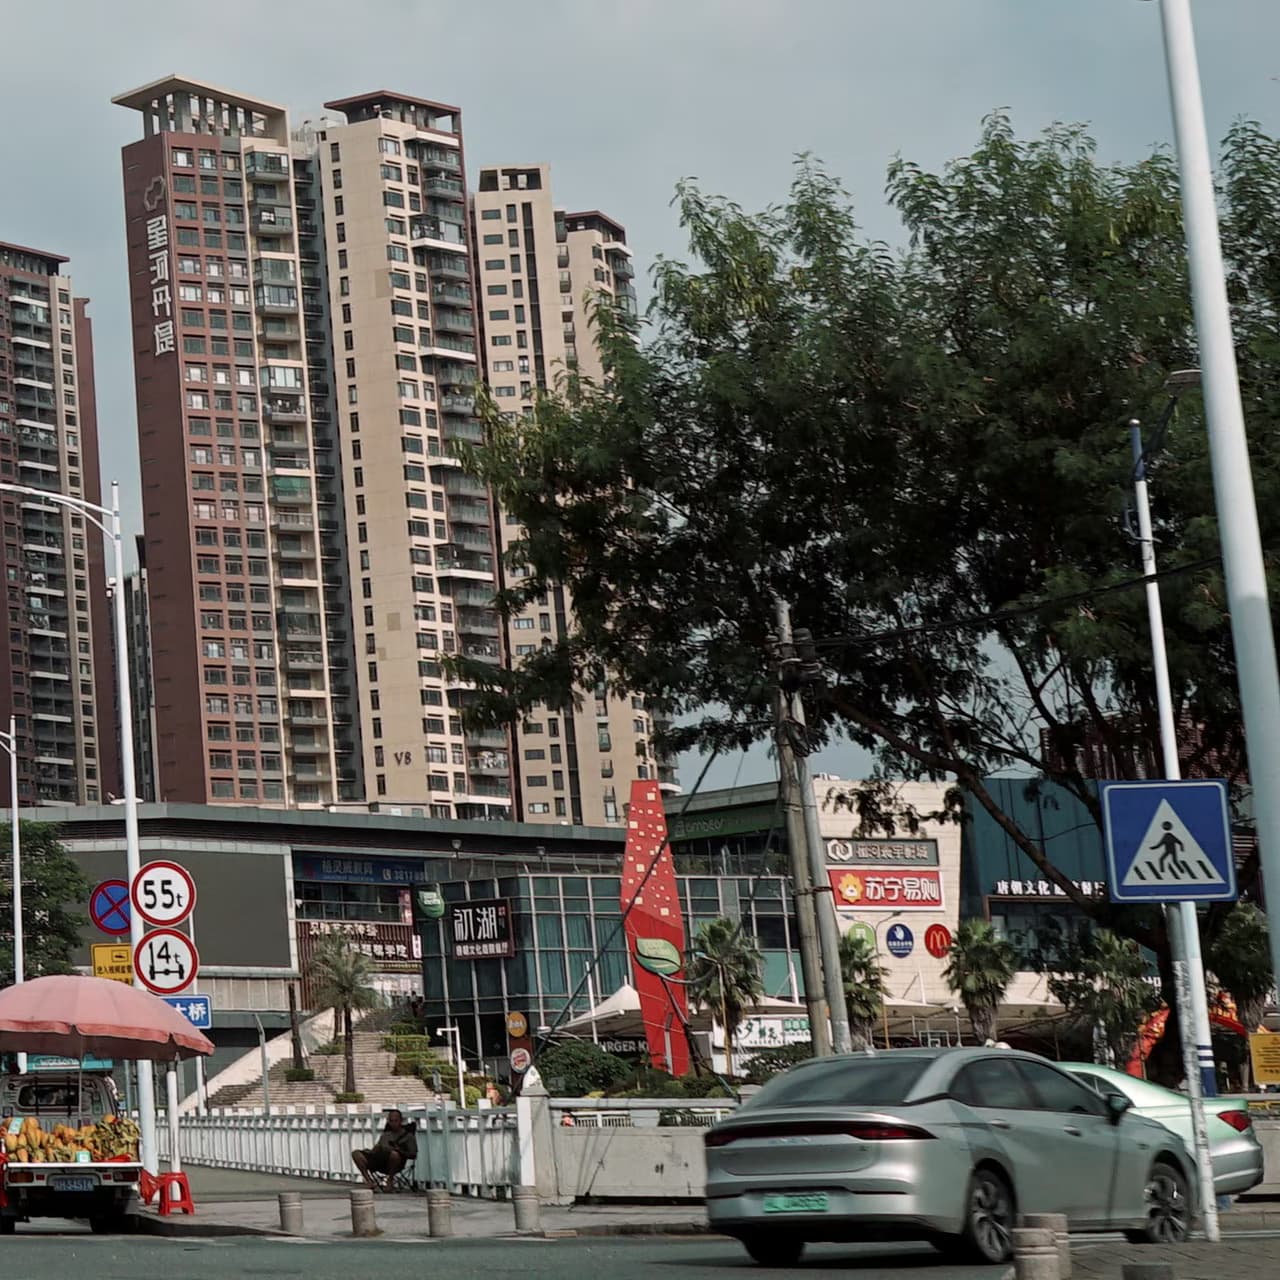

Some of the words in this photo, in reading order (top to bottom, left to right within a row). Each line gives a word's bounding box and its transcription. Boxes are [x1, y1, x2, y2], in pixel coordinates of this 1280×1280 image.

[146, 214, 175, 356] 星河丹堤
[143, 880, 183, 910] 55t
[864, 876, 940, 901] 苏宁易购
[148, 941, 180, 965] 14t
